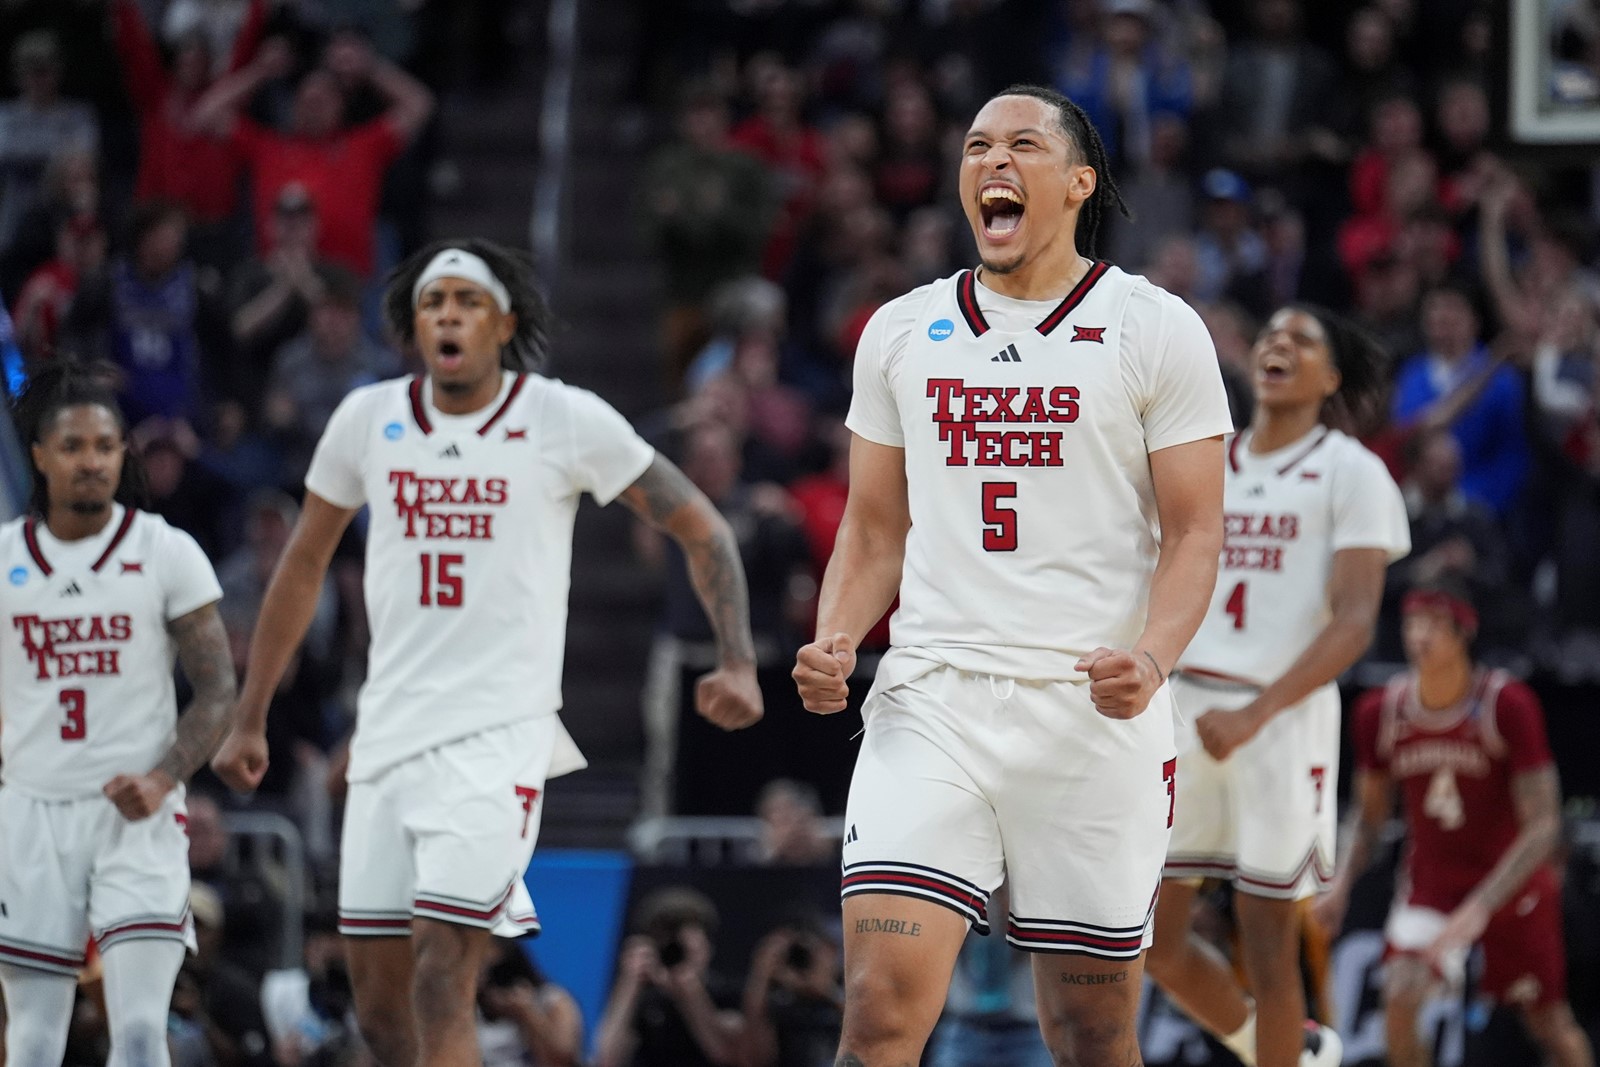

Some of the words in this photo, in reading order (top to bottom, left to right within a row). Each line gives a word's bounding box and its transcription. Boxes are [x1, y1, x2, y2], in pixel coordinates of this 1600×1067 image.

[981, 482, 1018, 552] 5
[1223, 515, 1298, 540] EXAS
[420, 553, 464, 607] 15
[1226, 581, 1247, 631] 4
[59, 689, 86, 740] 3
[855, 918, 922, 937] HUMBLE
